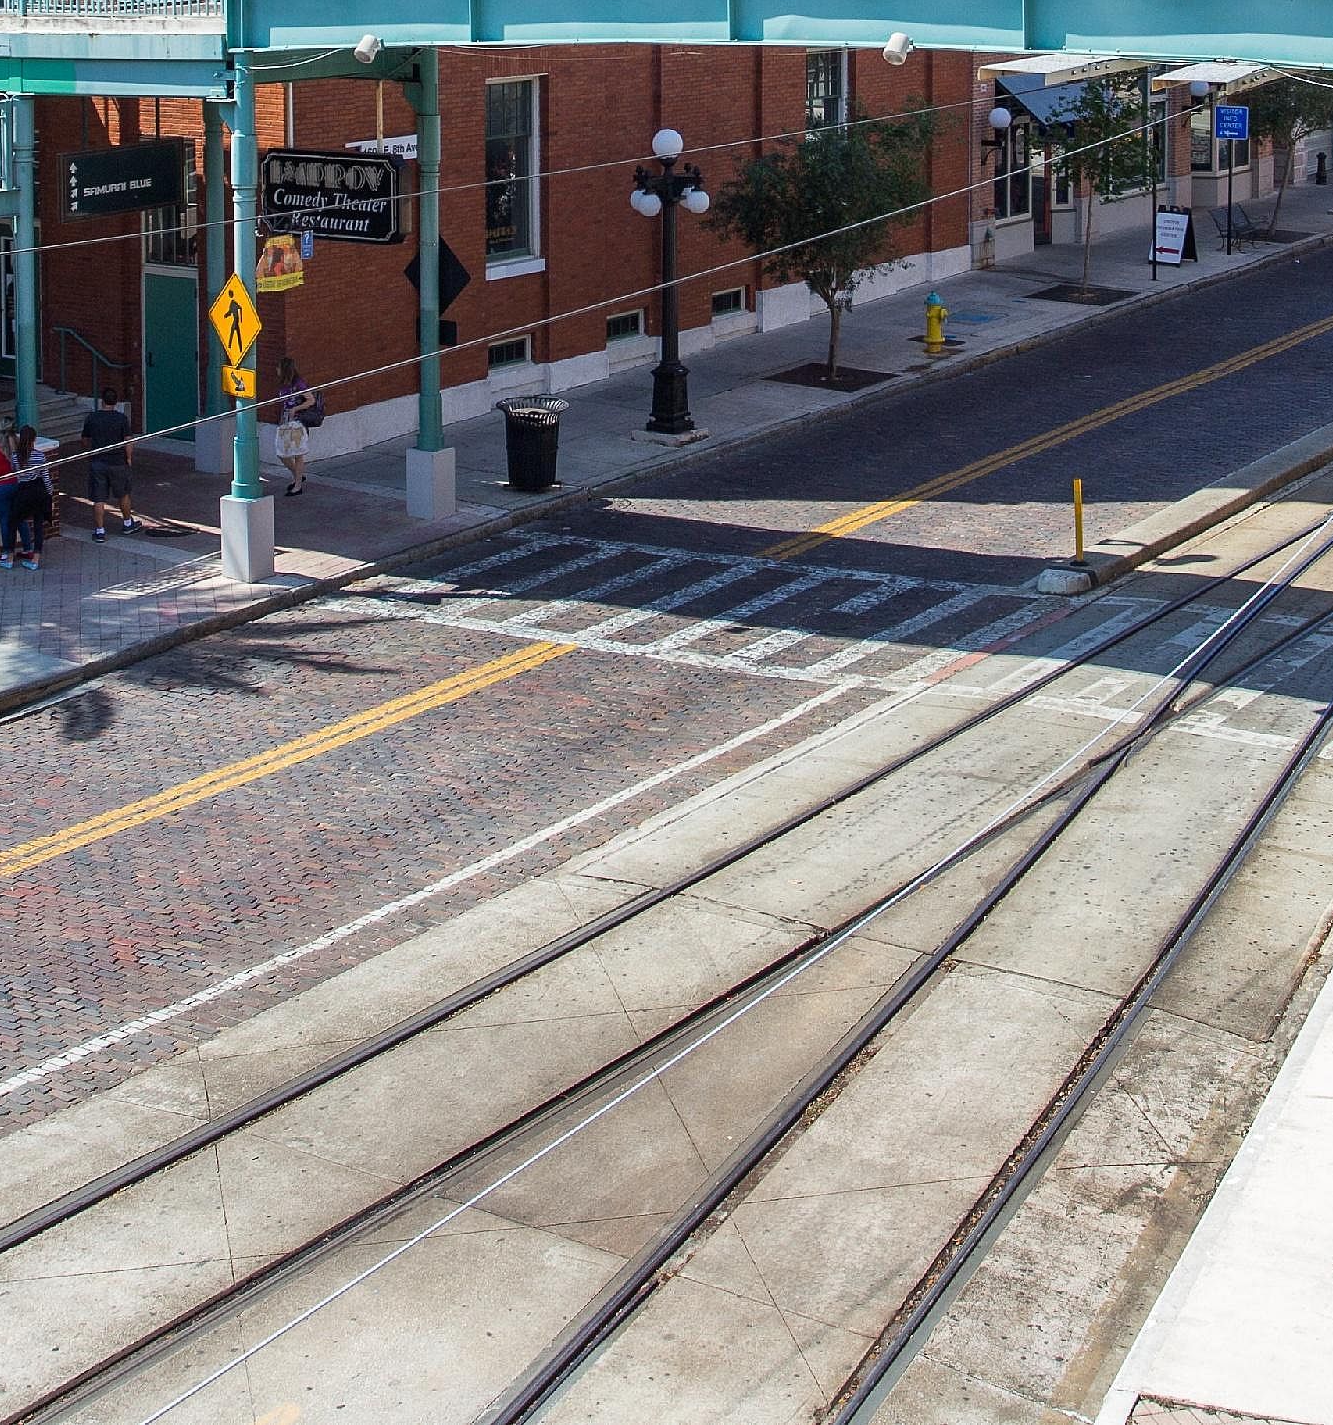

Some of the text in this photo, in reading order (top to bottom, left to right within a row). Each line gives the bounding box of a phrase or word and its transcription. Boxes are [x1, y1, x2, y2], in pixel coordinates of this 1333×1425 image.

[83, 178, 152, 197] SAMURAI BLUE
[274, 188, 388, 213] Comedy Theater
[291, 209, 370, 232] Restaurant
